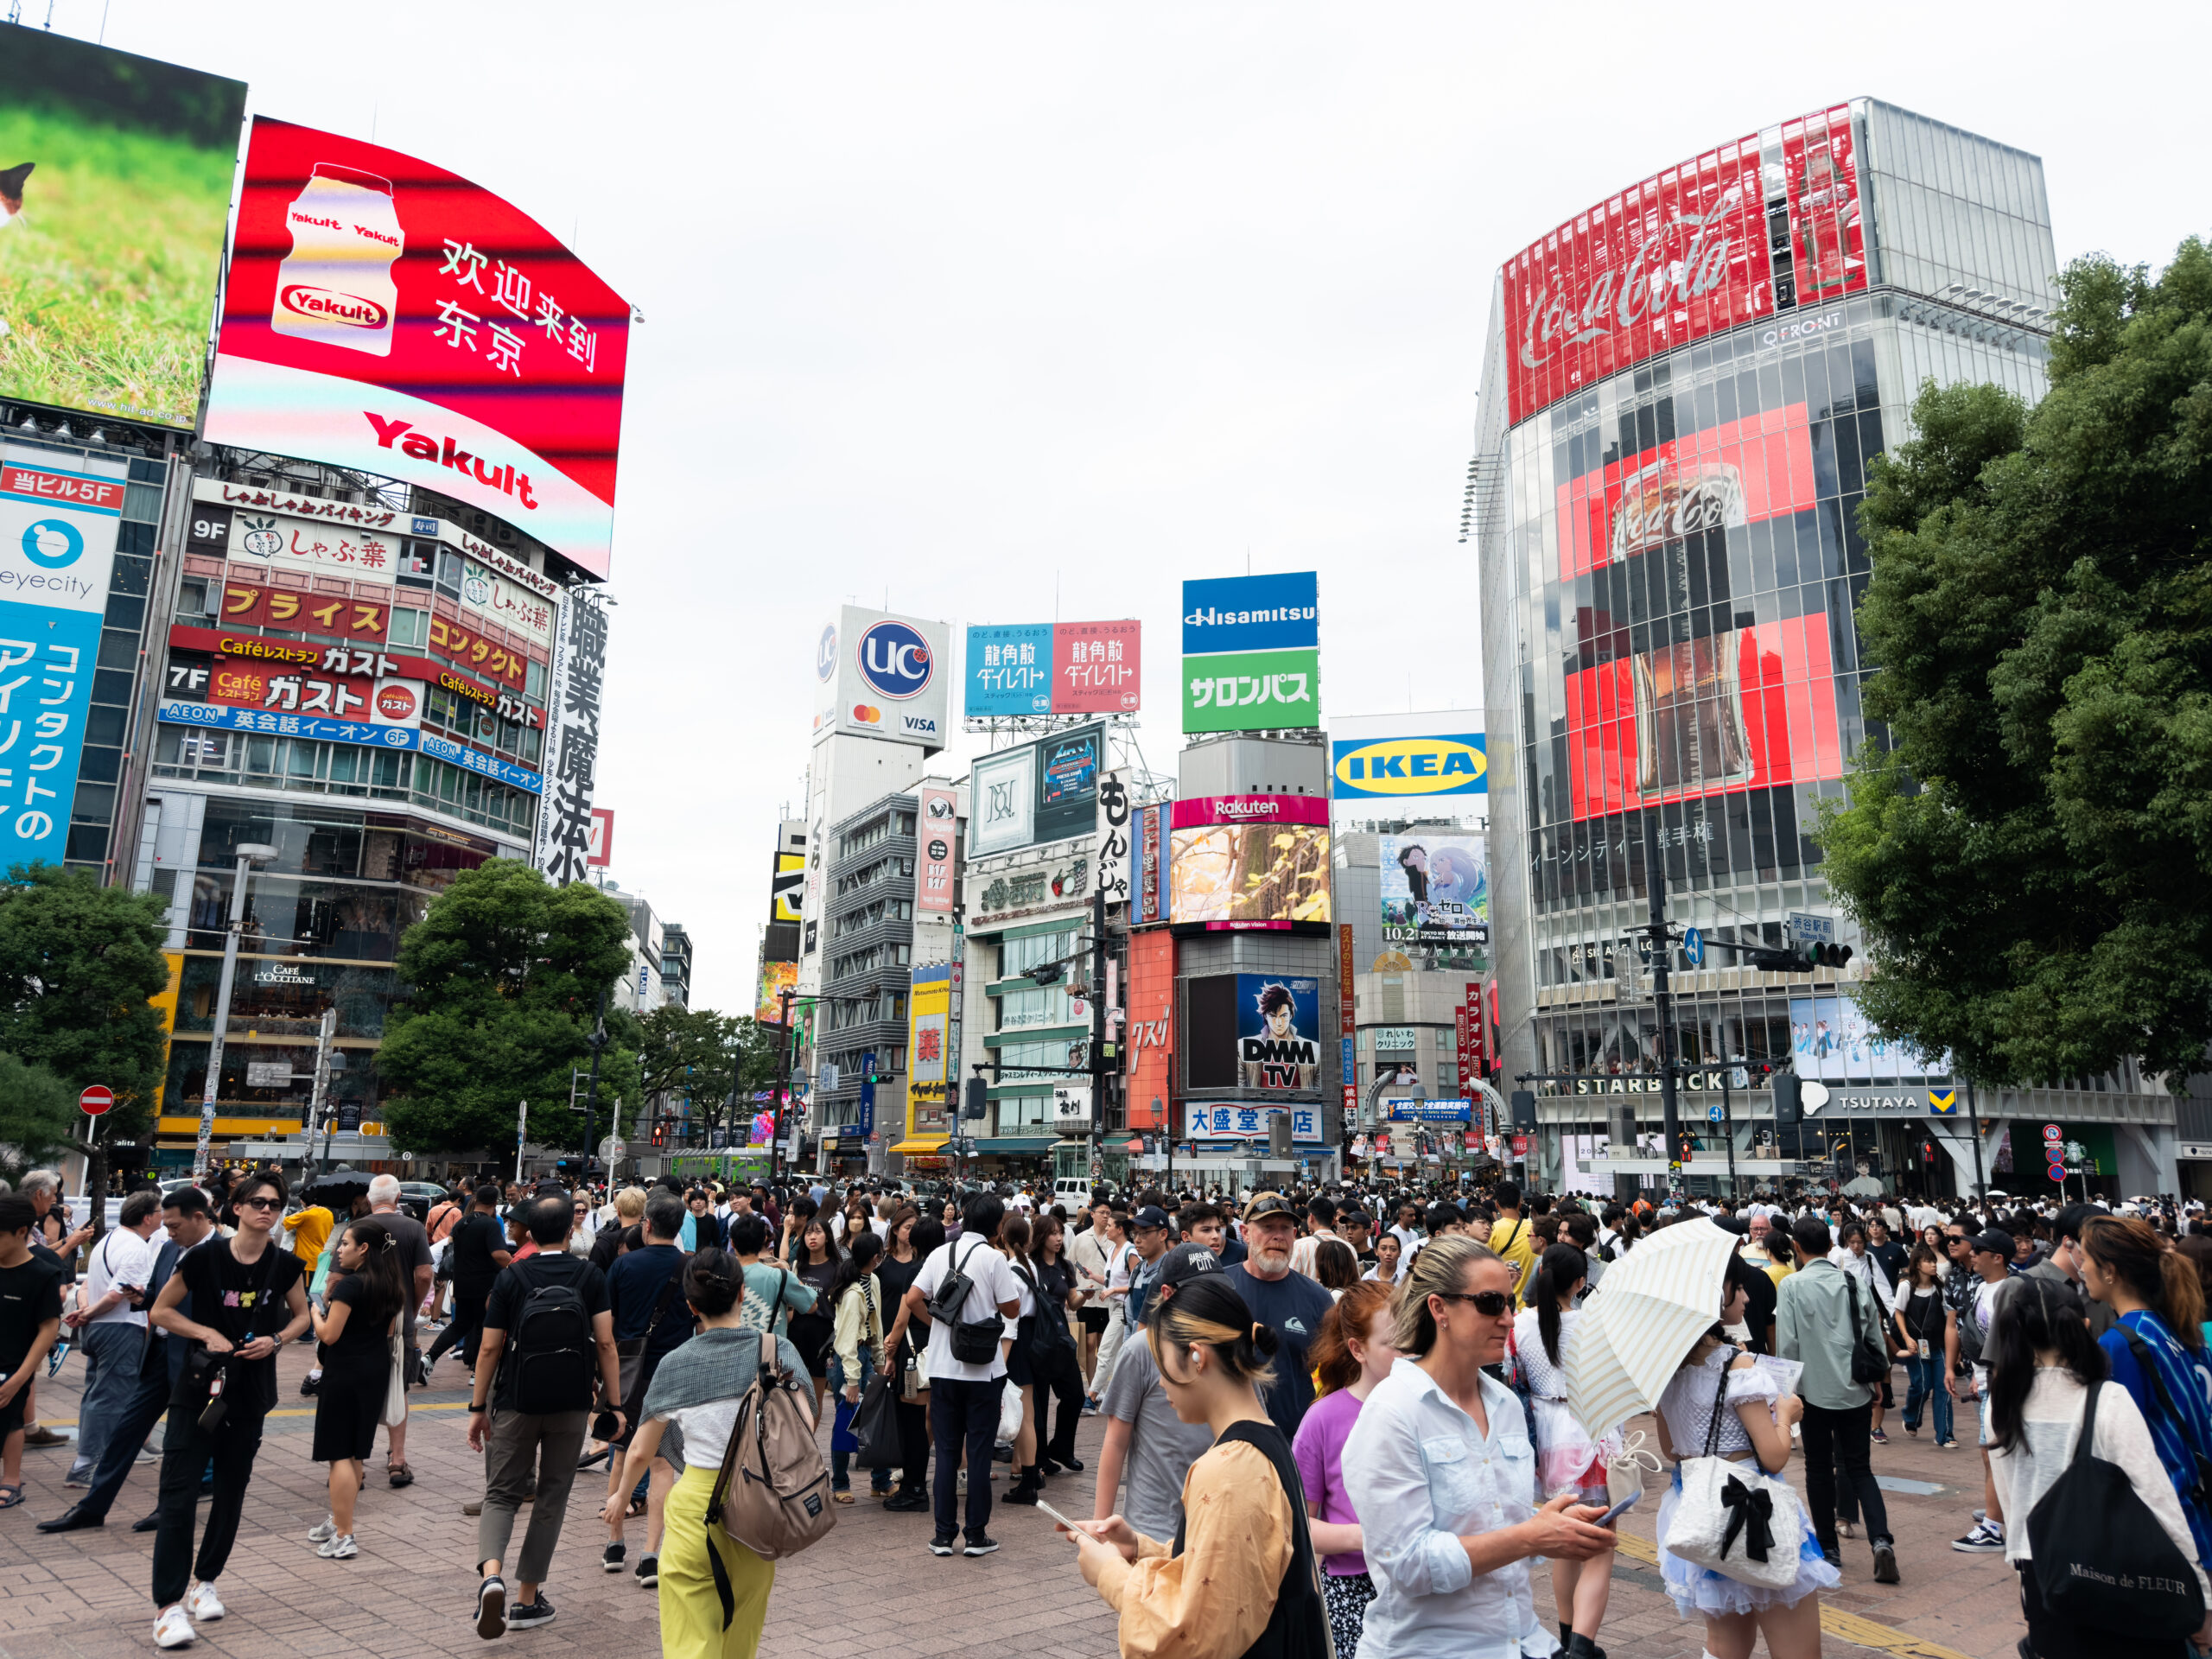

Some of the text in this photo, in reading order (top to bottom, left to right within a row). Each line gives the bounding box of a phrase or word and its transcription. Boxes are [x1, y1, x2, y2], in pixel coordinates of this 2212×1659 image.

[290, 211, 343, 231] Yakult
[353, 225, 400, 248] Yakult
[295, 290, 379, 324] Yakult
[438, 237, 598, 373] 欢迎来到
[433, 299, 526, 378] 东京
[87, 398, 188, 423] www.hit-ad.co.jp
[362, 410, 539, 510] Yakult
[13, 472, 112, 502] 当ビル5F
[223, 485, 397, 526] しゃぶしゃぶバイキング
[193, 519, 226, 540] 9F
[415, 520, 436, 533] 寿司
[290, 528, 387, 569] しゃぶ葉
[462, 533, 557, 595] しゃぶしゃぶバイキング
[0, 568, 93, 599] eyecity
[226, 588, 384, 633] プライス
[493, 583, 549, 632] しゃぶ葉
[1184, 606, 1315, 626] Hisamitsu
[972, 629, 1048, 639] のど、直接、うるおう
[1059, 626, 1135, 635] のど、直接、うるおう
[429, 618, 522, 680] コンタクト
[867, 637, 925, 680] UC
[984, 642, 1036, 666] 龍角散
[1072, 639, 1124, 663] 龍角散
[322, 646, 398, 678] ガスト
[169, 666, 209, 690] 7F
[218, 672, 262, 691] Café
[976, 665, 1045, 690] ダイレクト
[1064, 664, 1133, 687] ダイレクト
[218, 690, 260, 701] レストラン
[264, 675, 365, 716] ガスト
[1191, 672, 1310, 708] サロンパス
[380, 699, 412, 712] ガスト
[497, 694, 538, 727] ガスト
[1033, 698, 1049, 707] 生薬
[168, 704, 218, 722] AEON
[388, 732, 407, 743] 6F
[902, 716, 936, 733] VISA
[15, 643, 79, 841] コンタクトの
[427, 737, 456, 758] AEON
[1350, 752, 1478, 780] IKEA
[1215, 799, 1279, 817] Rakuten
[1098, 772, 1128, 898] もんじゃ
[807, 930, 815, 943] 7F
[1385, 927, 1414, 941] 10.2
[1446, 930, 1485, 940] 放送開始
[1793, 916, 1832, 934] 渋谷駅前
[1799, 931, 1817, 941] Shibuya
[1342, 926, 1351, 995] クスリのことなら
[255, 971, 315, 984] L'OCCITANE
[639, 976, 648, 993] LABI
[1467, 990, 1482, 1049] カラオケ
[918, 1027, 940, 1062] 薬
[1130, 1004, 1171, 1074] クスリ
[1243, 1038, 1316, 1065] DMM
[1263, 1064, 1296, 1087] TV
[1059, 1100, 1080, 1115] 松川
[1344, 1088, 1356, 1107] 焼肉
[1395, 1102, 1469, 1110] 全国交安全運動実施中
[1840, 1096, 1918, 1109] TSUTAYA
[1192, 1109, 1313, 1133] 大盛堂店
[1197, 1257, 1212, 1271] CITY
[2070, 1562, 2188, 1596] Maison de FLEUR
